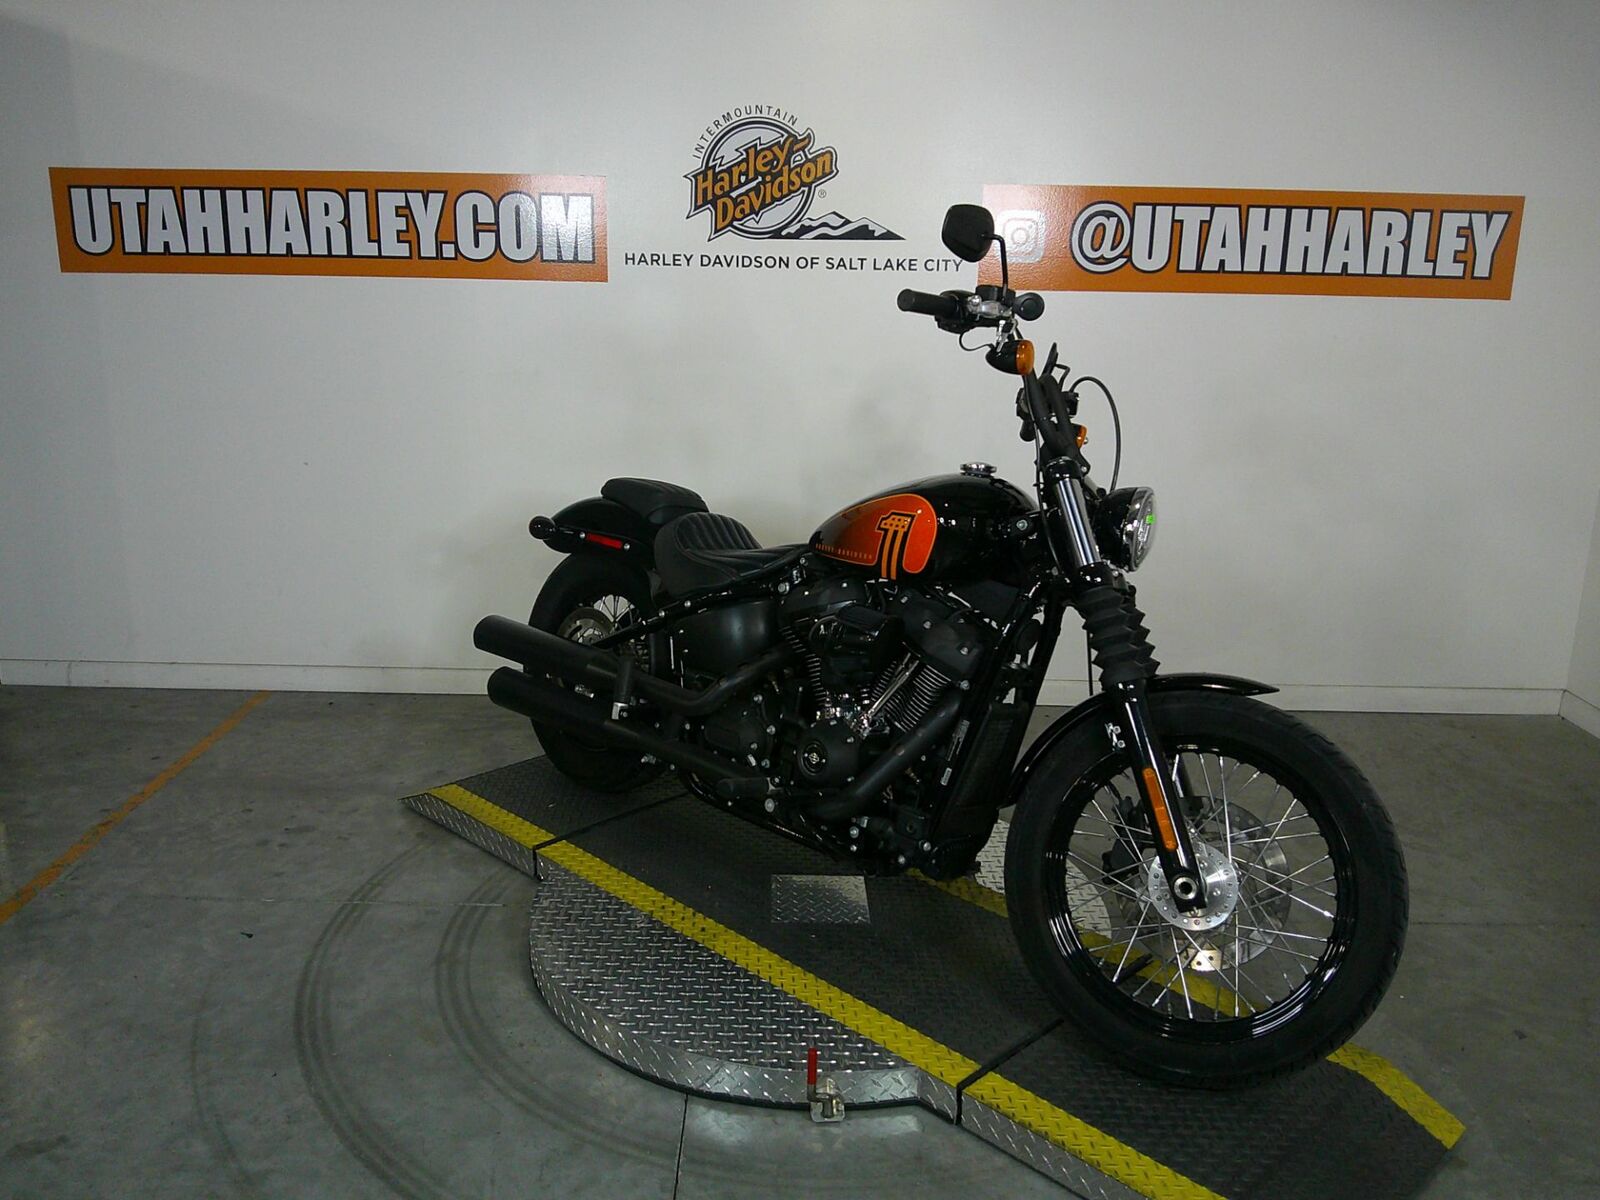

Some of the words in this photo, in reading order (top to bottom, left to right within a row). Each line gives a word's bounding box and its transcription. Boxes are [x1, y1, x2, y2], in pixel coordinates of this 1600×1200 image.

[693, 104, 798, 160] INTERMOUNTAIN
[67, 185, 595, 264] UTAHHARLEY.COM
[716, 149, 833, 231] Davidson
[625, 253, 694, 267] HARLEY
[700, 254, 790, 269] DAVIDSON
[796, 256, 820, 270] OF
[825, 257, 867, 271] SALT
[873, 258, 918, 272] LAKE
[924, 259, 964, 273] CITY
[1070, 201, 1512, 280] @UTAHHARLEY
